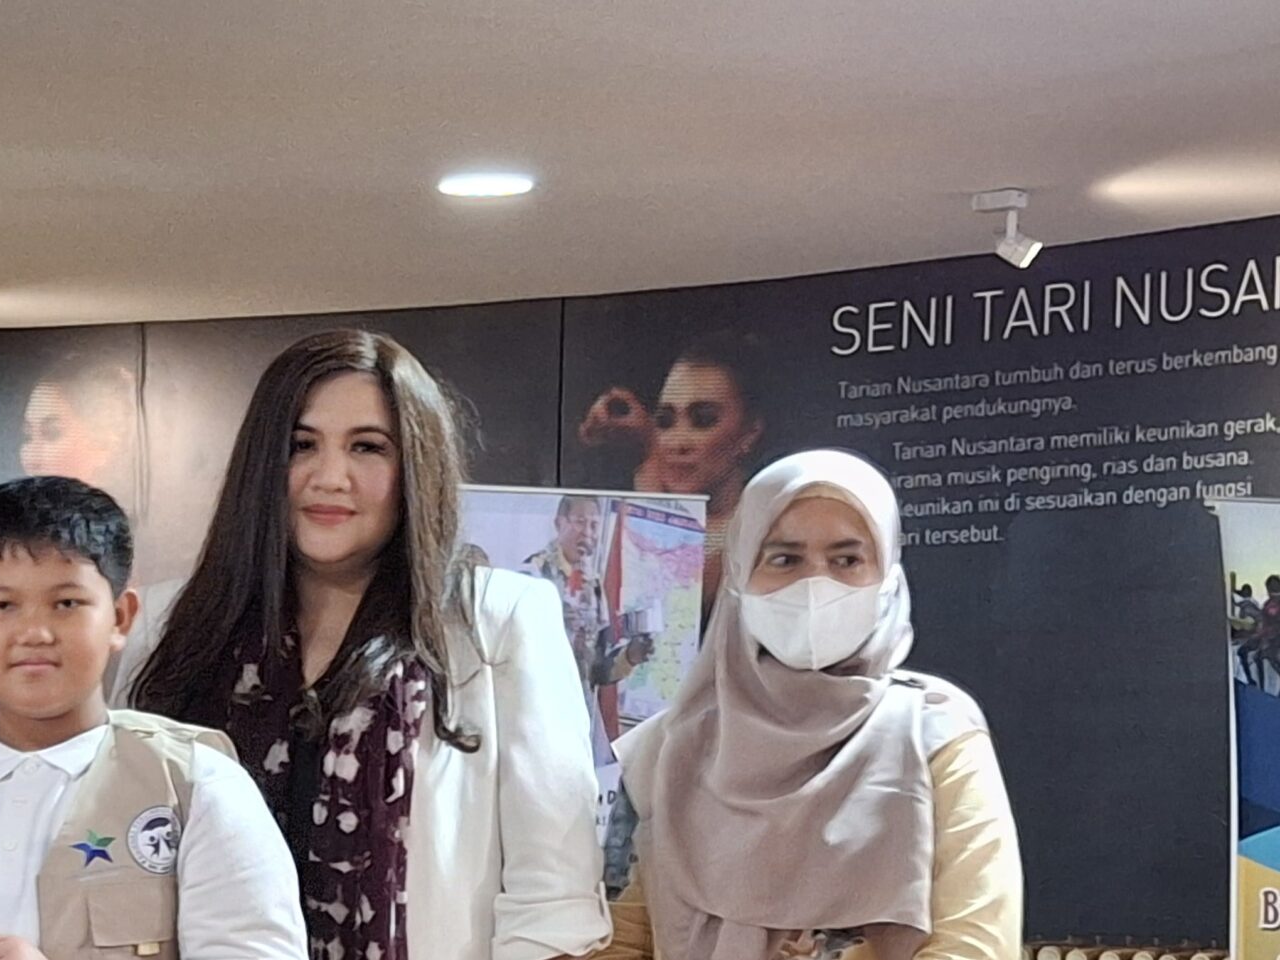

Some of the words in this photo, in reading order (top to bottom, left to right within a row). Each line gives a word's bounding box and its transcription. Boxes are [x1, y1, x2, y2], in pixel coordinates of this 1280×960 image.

[831, 295, 953, 355] SENI
[973, 280, 1090, 341] TARI
[838, 379, 892, 399] Tarian
[897, 373, 990, 395] Nusantara
[995, 363, 1064, 386] tumbuh
[1069, 361, 1103, 380] dan
[1109, 357, 1158, 376] terus
[1162, 344, 1278, 373] berkembang
[837, 404, 937, 429] masyarakat
[942, 395, 1077, 424] pendukungnya.
[893, 440, 946, 461] Tarian
[951, 436, 1044, 457] Nusantara
[1050, 427, 1130, 449] memiliki
[1135, 420, 1219, 443] keunikan
[947, 465, 1001, 486] musik
[1103, 457, 1138, 475] rias
[1143, 454, 1176, 473] dan
[978, 493, 999, 512] ini
[1005, 492, 1019, 511] di
[1025, 487, 1117, 511] sesuaikan
[1122, 485, 1190, 509] dengan
[1196, 476, 1252, 499] fungsi
